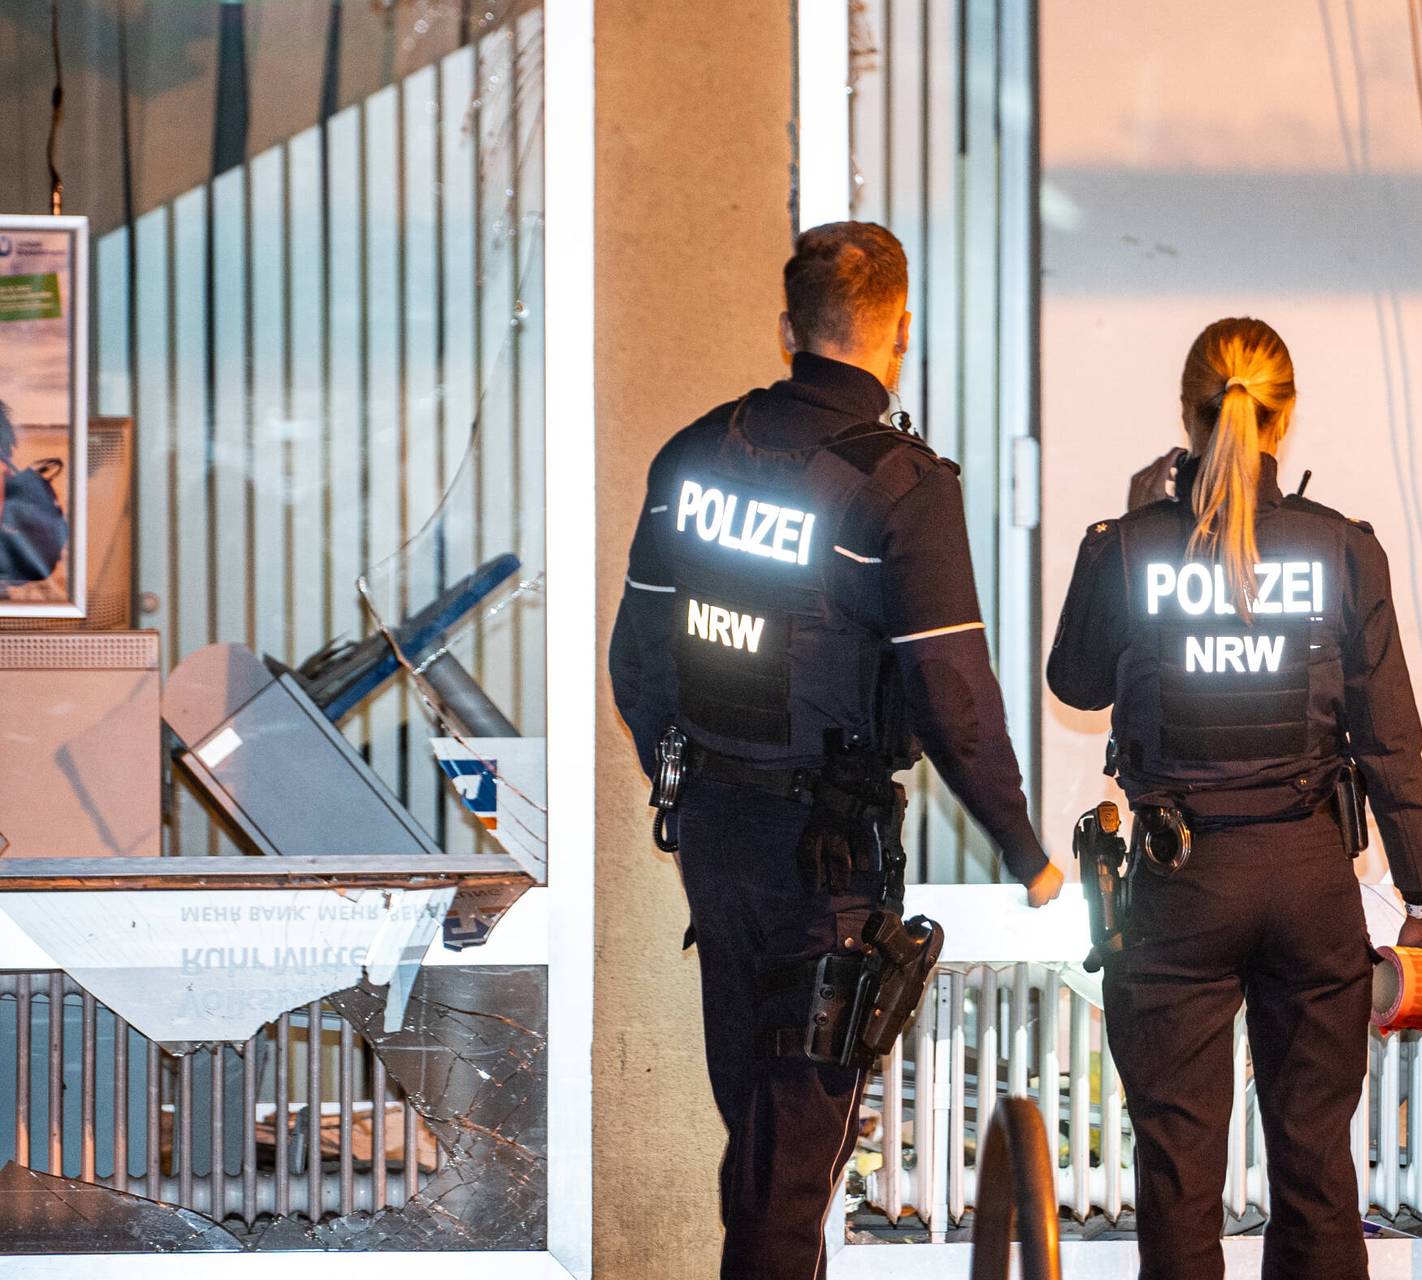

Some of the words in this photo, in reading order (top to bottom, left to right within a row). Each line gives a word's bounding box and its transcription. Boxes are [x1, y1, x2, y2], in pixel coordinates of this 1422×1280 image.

[677, 480, 816, 565] POLIZEI
[1147, 561, 1323, 614] POLZEI
[687, 599, 765, 653] NRW
[1185, 635, 1286, 673] NRW
